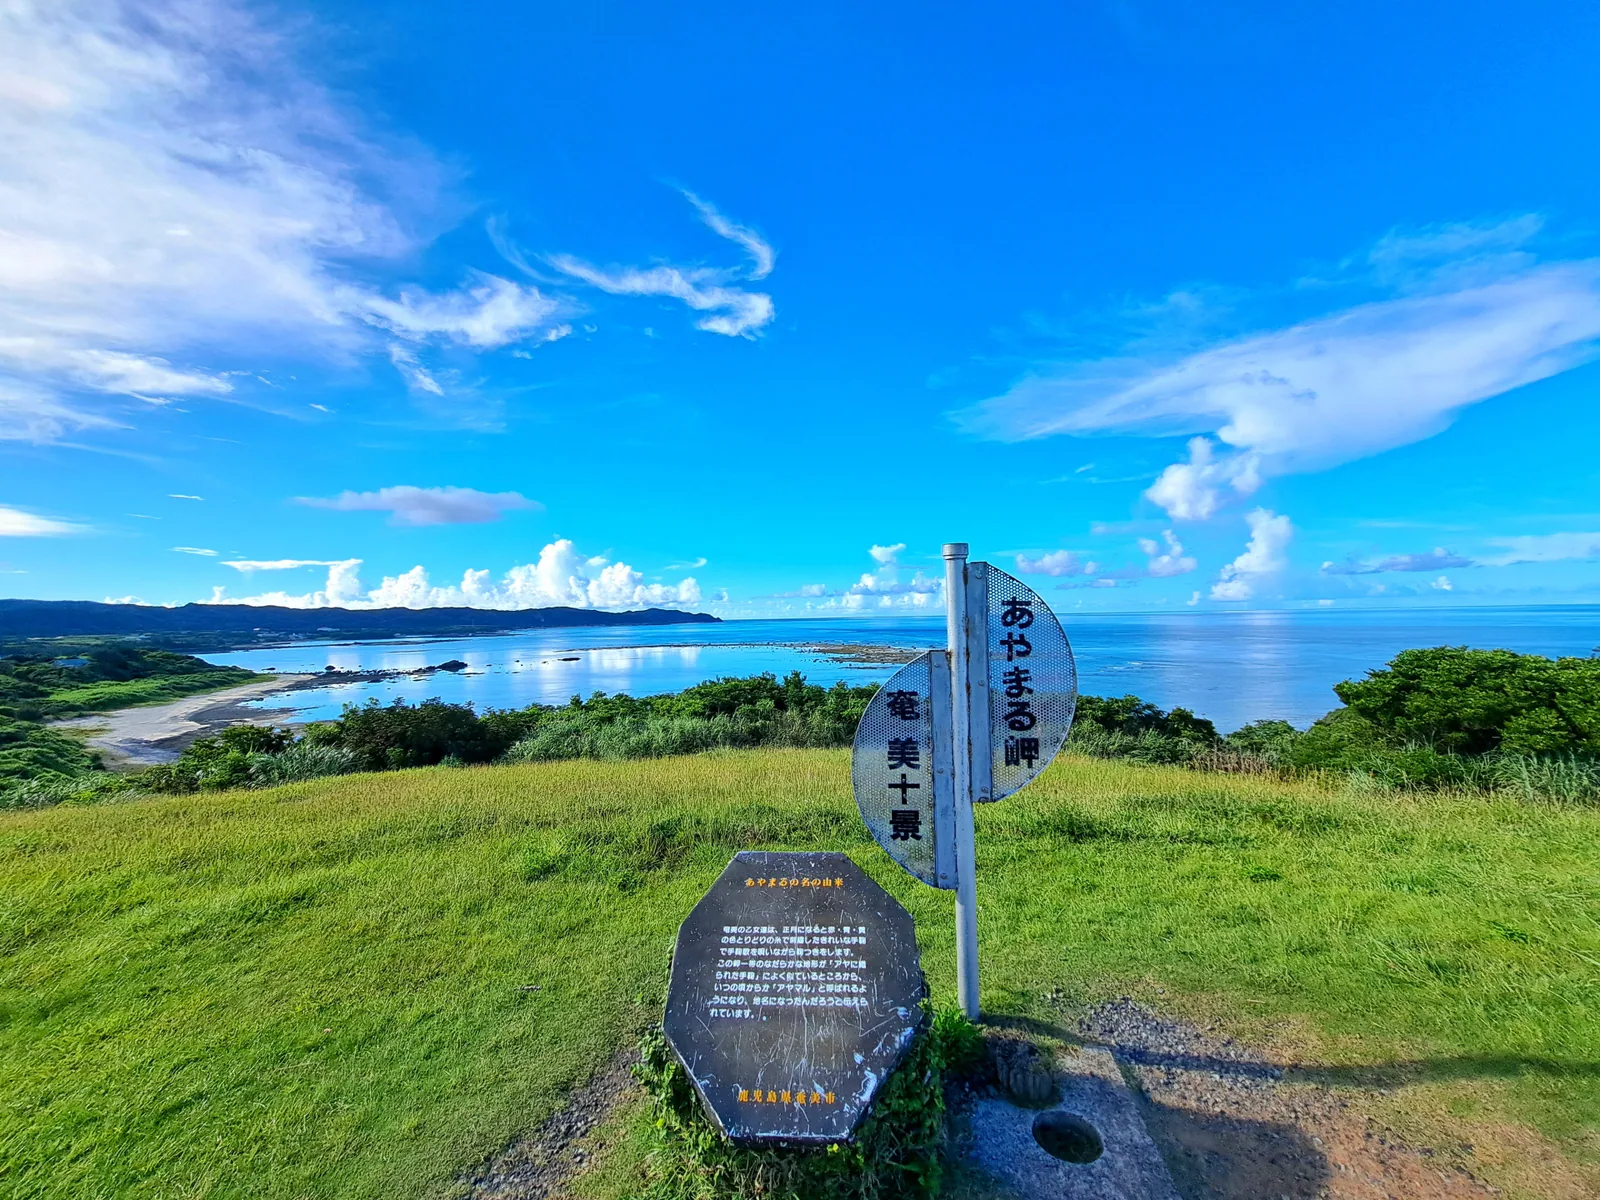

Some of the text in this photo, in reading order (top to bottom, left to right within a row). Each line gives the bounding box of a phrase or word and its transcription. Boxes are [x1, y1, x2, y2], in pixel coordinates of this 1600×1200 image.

[999, 595, 1040, 769] あやまる岬
[886, 689, 923, 842] 奄美十景
